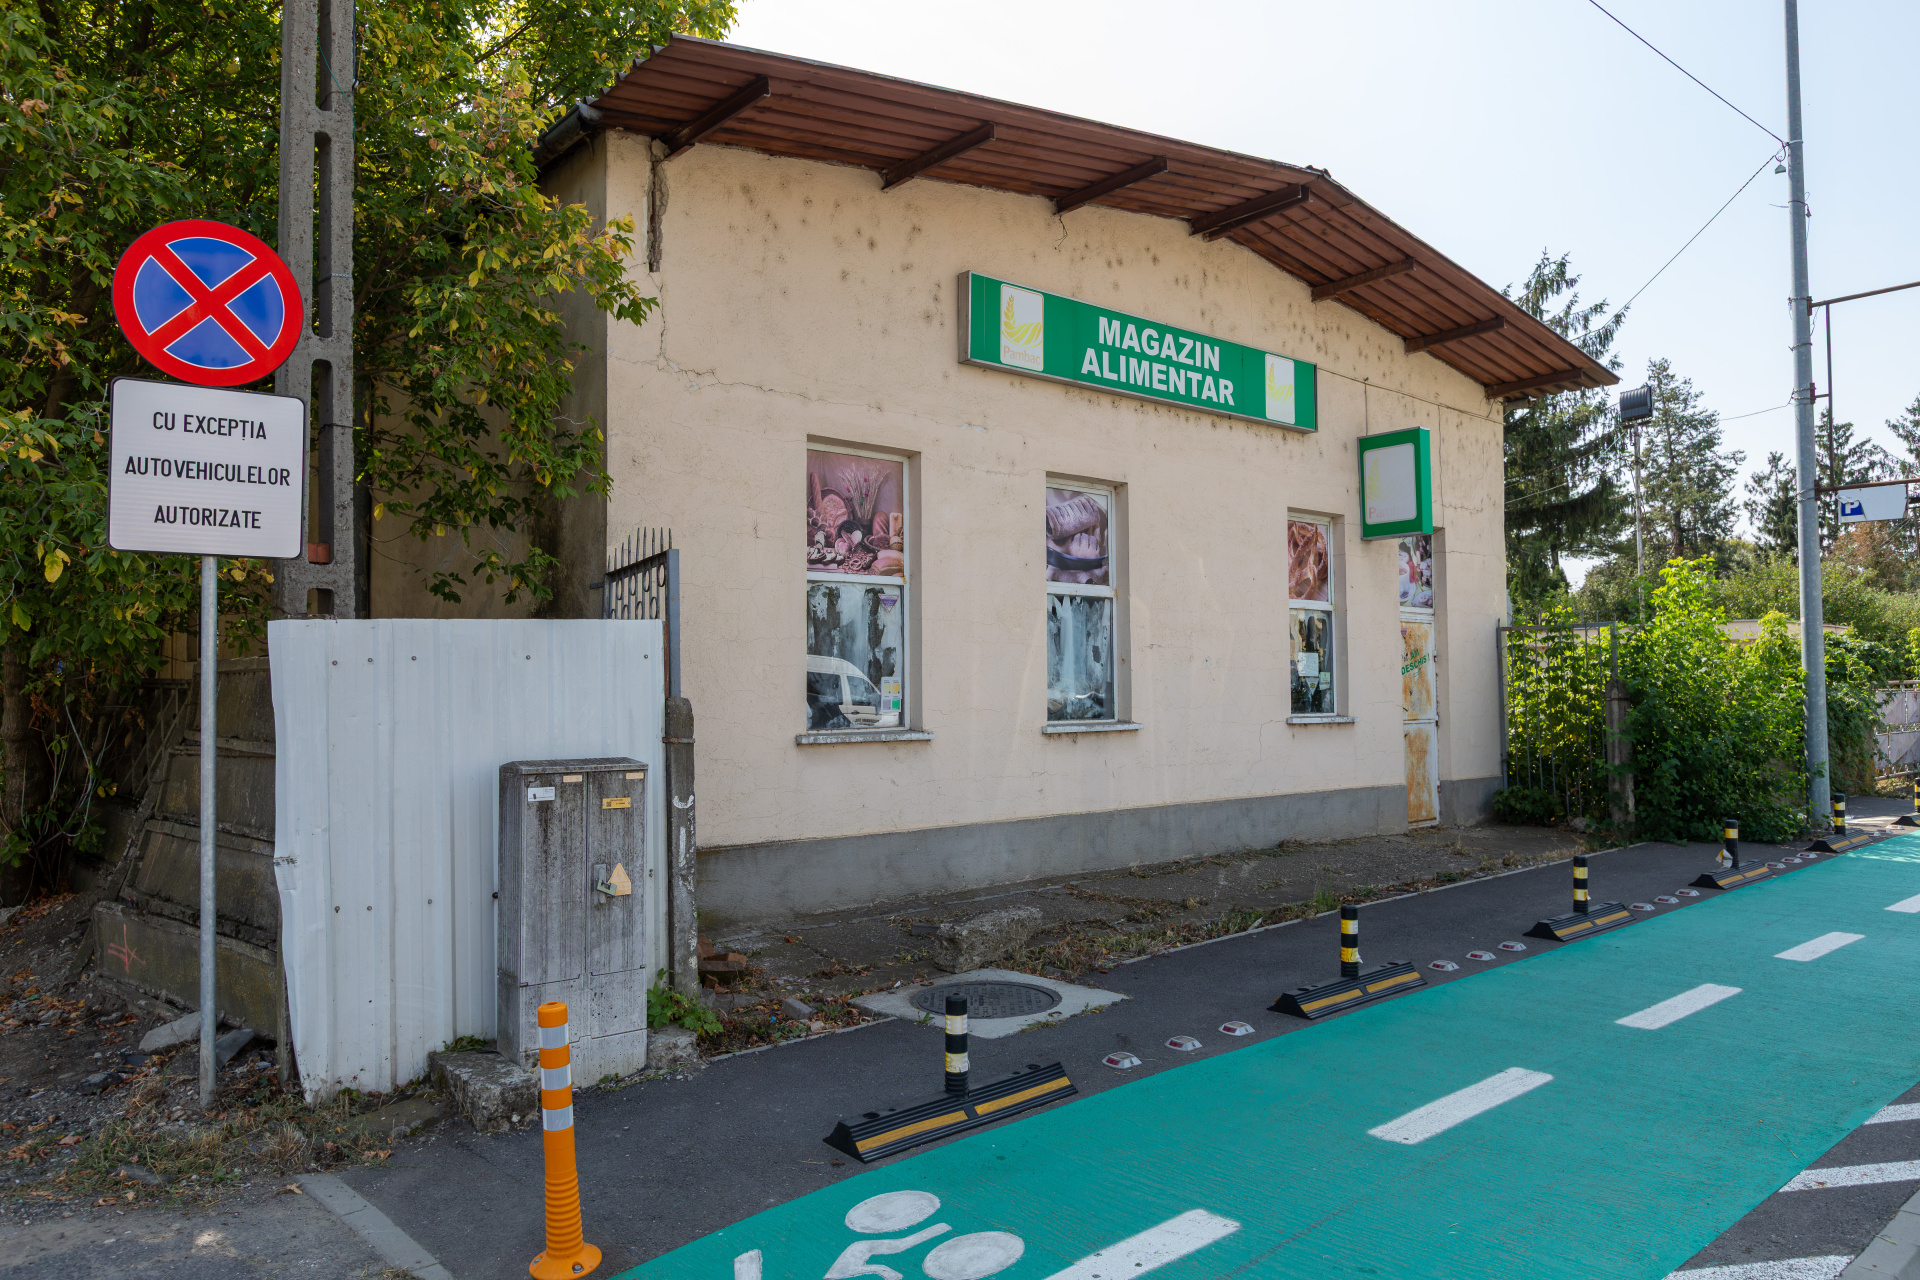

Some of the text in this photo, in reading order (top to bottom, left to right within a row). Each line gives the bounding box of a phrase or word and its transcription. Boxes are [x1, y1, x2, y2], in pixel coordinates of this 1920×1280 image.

[1003, 345, 1041, 366] Pambac
[1098, 316, 1220, 371] MAGAZIN
[1081, 348, 1235, 406] ALIMENTAR
[152, 410, 267, 441] CU EXCEPȚIA
[124, 456, 291, 487] AUTOVEHICULELOR
[153, 504, 262, 530] AUTORIZATE
[1845, 500, 1859, 514] P
